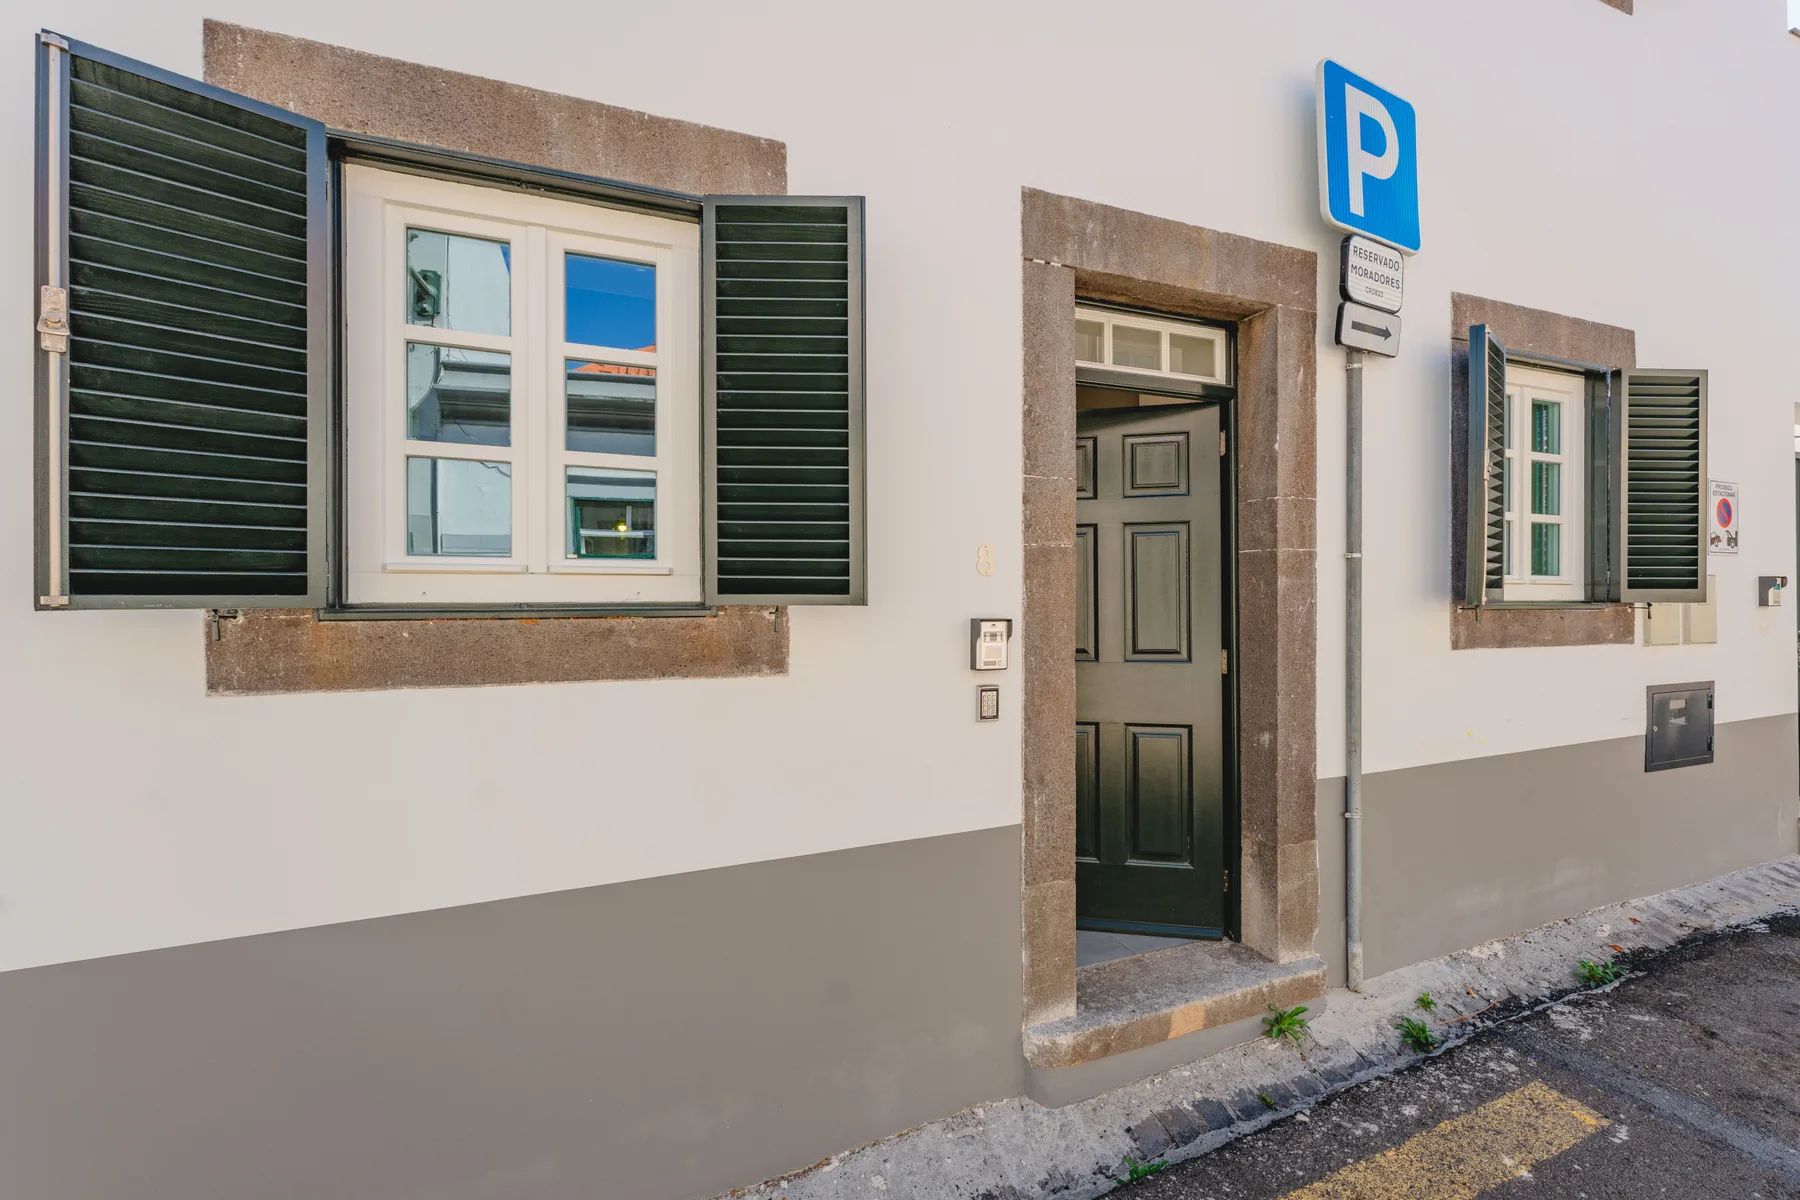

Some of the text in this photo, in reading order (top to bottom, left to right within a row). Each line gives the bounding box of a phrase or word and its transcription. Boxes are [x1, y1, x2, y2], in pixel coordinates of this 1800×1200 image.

[1345, 82, 1399, 217] P
[1353, 245, 1400, 271] RESERVADO
[1350, 263, 1400, 290] MORADORES
